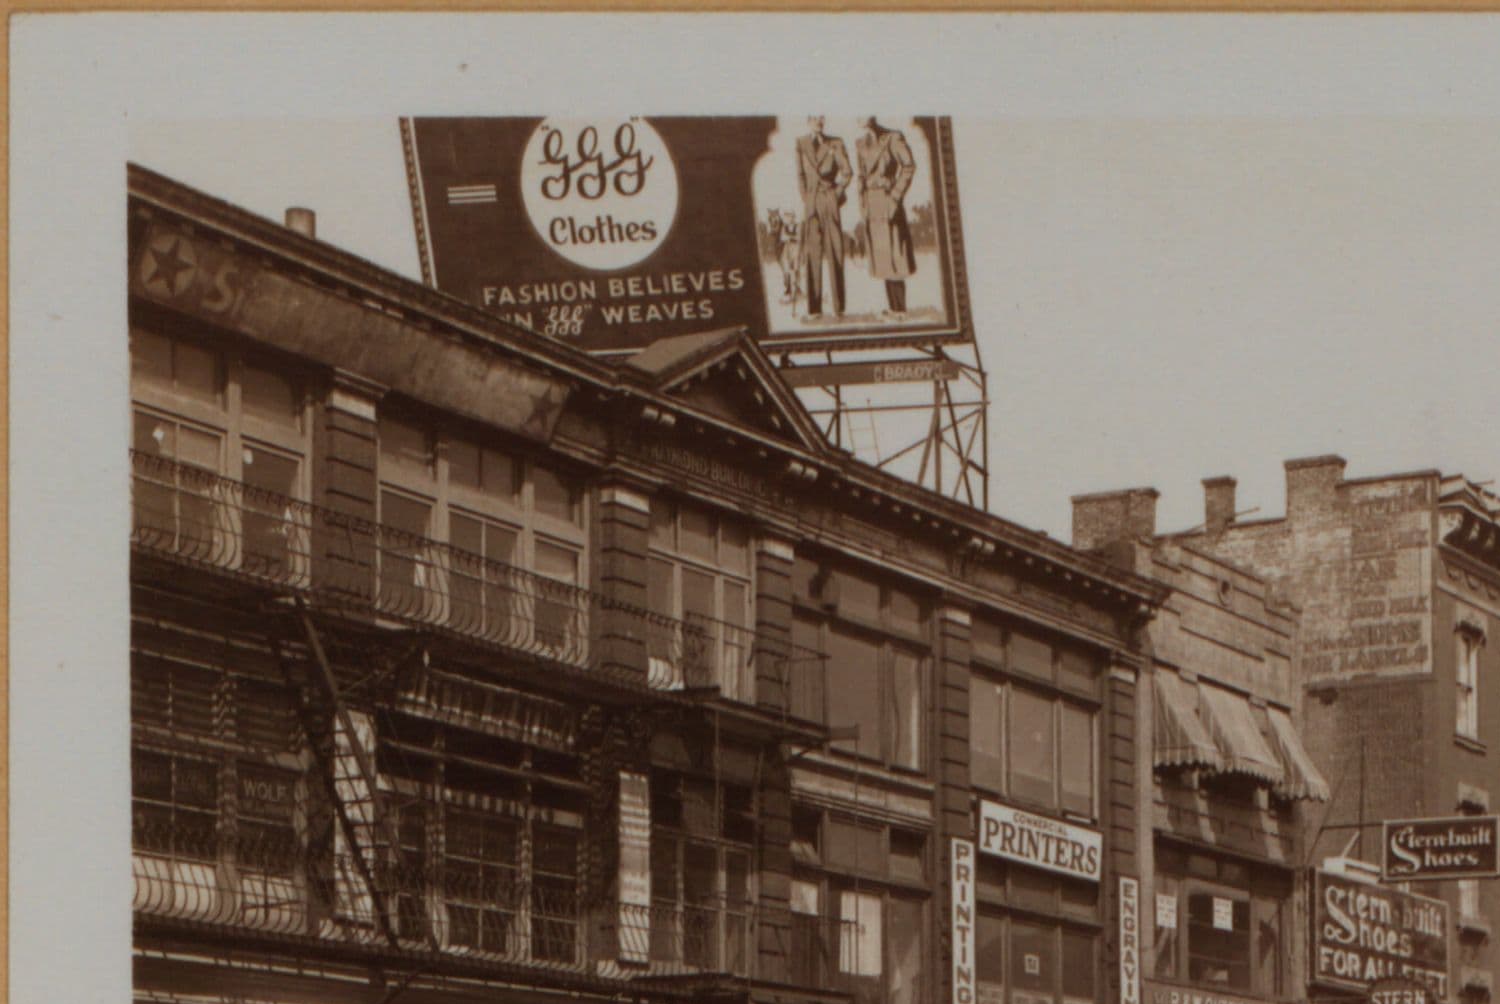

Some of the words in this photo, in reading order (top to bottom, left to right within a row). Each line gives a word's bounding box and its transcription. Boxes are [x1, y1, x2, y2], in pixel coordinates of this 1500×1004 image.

[549, 215, 657, 245] Clothes
[483, 279, 596, 305] FASHION
[608, 269, 745, 297] BELIEVES
[601, 300, 714, 324] WEAVES
[1013, 812, 1067, 835] COMMERCIAL
[984, 817, 1098, 874] PRINTERS
[955, 843, 972, 1004] PRINTING
[1320, 946, 1361, 979] FOR
